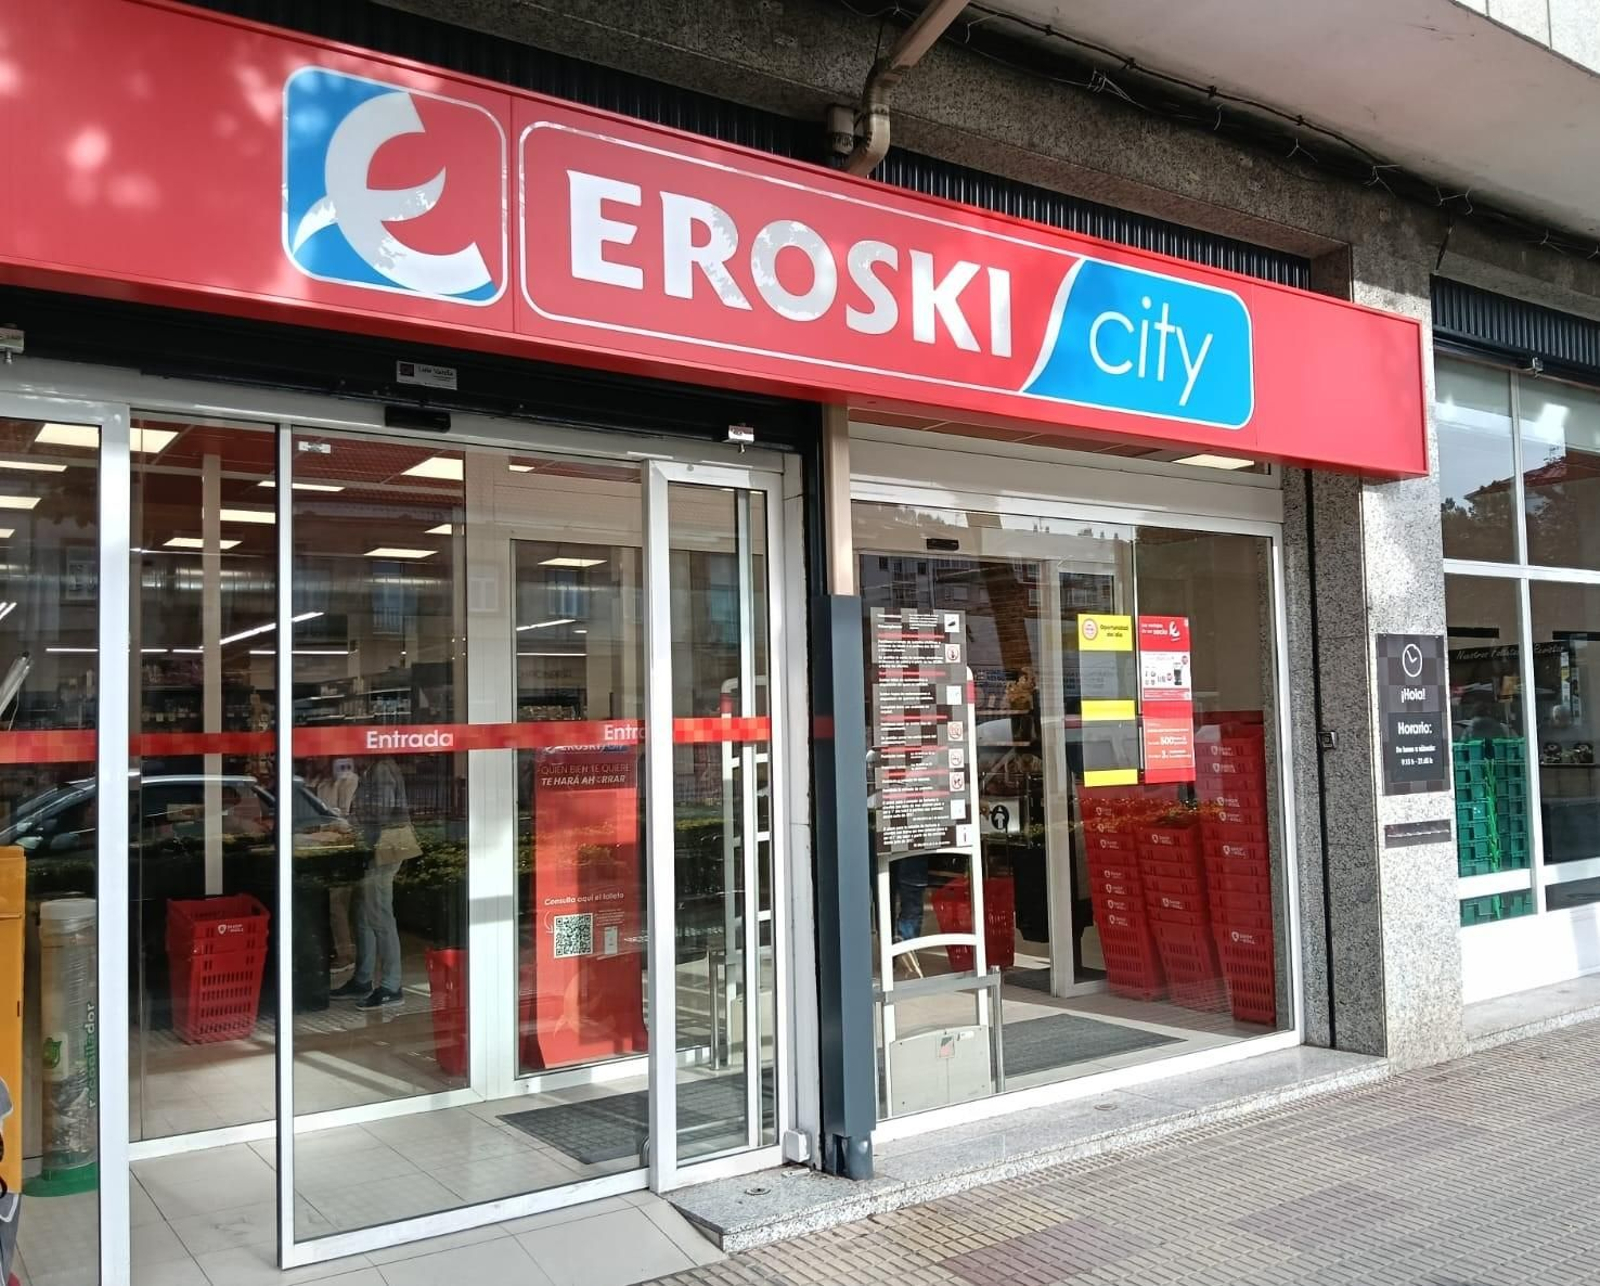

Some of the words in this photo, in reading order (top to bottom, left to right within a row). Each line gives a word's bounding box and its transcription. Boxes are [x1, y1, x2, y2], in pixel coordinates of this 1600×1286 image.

[567, 170, 1012, 358] EROSKI
[1089, 295, 1214, 407] city
[1401, 687, 1427, 704] ¡Hola!
[1397, 721, 1433, 736] Horario:
[366, 729, 454, 749] Entrada
[541, 777, 552, 786] TE
[553, 774, 580, 786] HARÁ
[544, 896, 576, 906] Consulta
